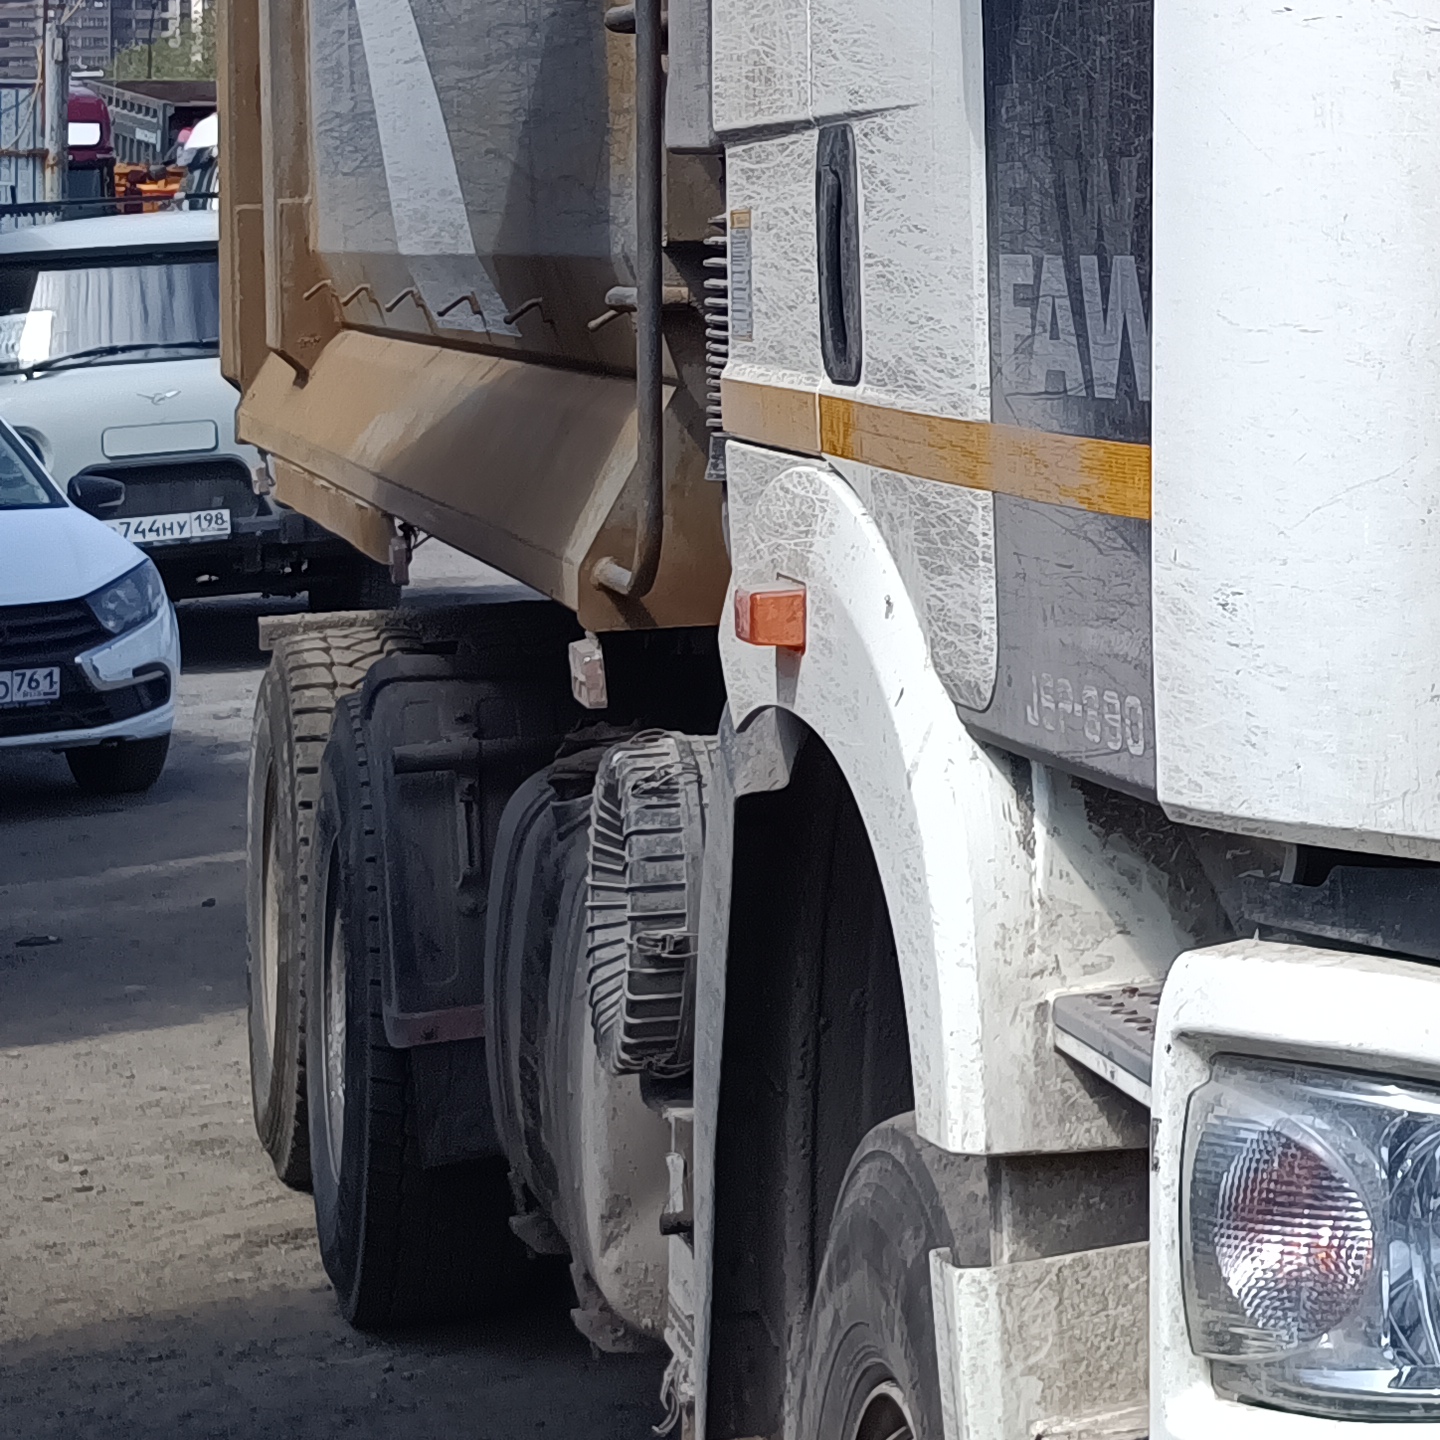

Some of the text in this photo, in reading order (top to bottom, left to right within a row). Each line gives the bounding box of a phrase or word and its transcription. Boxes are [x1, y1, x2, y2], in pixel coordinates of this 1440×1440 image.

[998, 254, 1151, 401] FAW
[110, 511, 226, 540] 744НУ 198
[14, 669, 55, 692] 761
